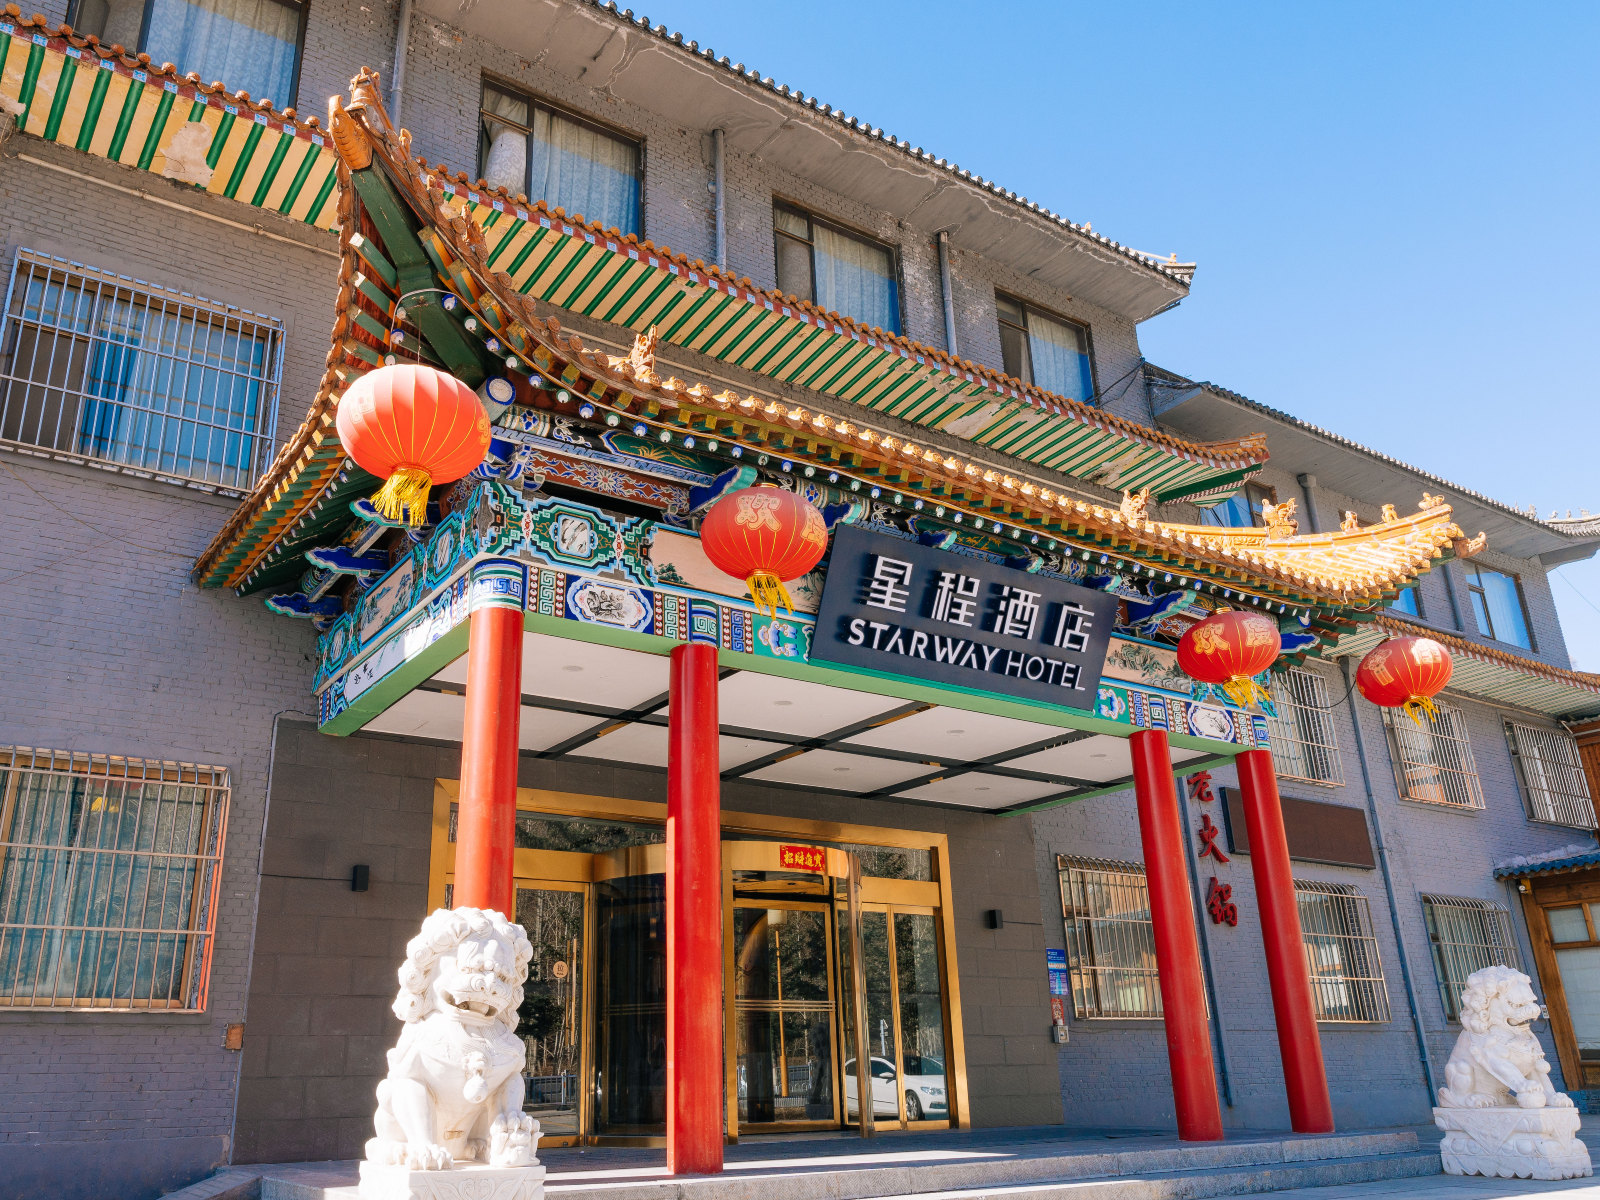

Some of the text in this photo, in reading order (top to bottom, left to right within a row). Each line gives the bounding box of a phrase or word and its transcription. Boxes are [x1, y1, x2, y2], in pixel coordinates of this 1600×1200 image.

[866, 555, 1095, 653] 星程酒店
[847, 618, 1086, 692] STARWAY HOTEL
